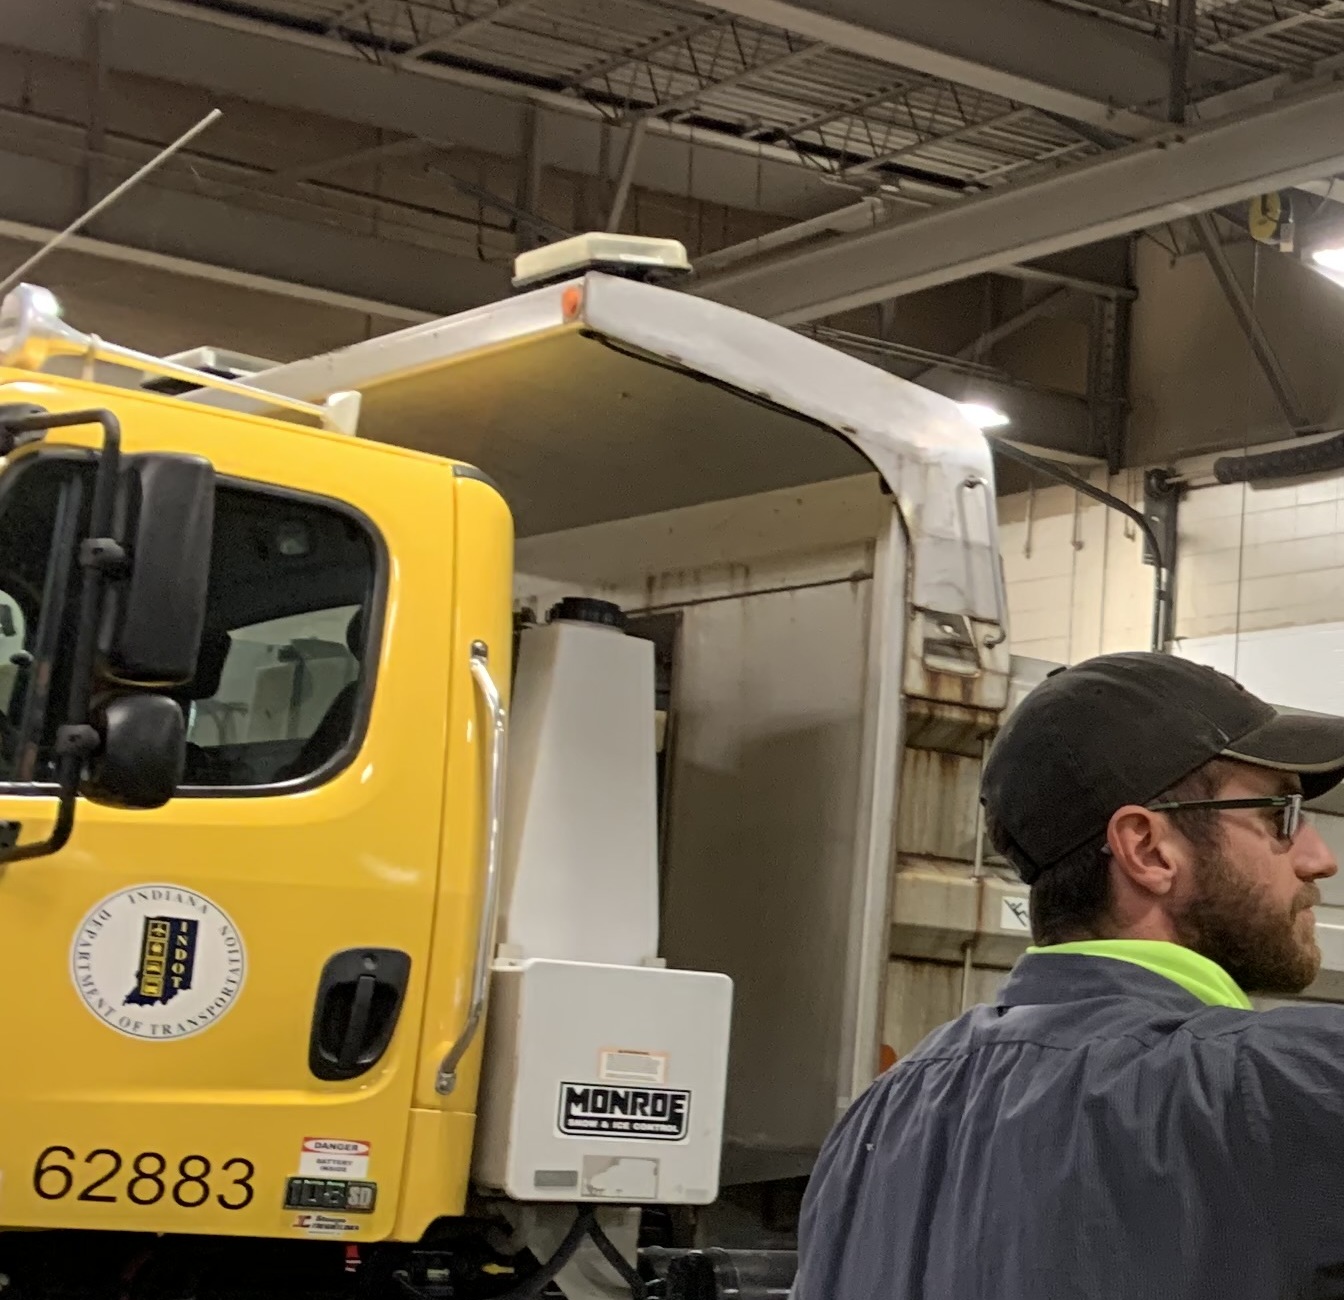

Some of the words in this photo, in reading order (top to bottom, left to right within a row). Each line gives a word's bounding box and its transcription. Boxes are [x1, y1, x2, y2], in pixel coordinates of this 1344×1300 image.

[127, 889, 208, 914] INDIANA
[170, 921, 189, 989] INDOT
[77, 908, 117, 1018] DEPARTMENT
[118, 1016, 143, 1033] OF
[150, 925, 241, 1036] TRANSPORTATION
[565, 1086, 686, 1118] MONROE
[567, 1118, 598, 1128] SNOW
[612, 1121, 631, 1131] ICE
[632, 1122, 680, 1133] CONTROL
[314, 1141, 359, 1151] DANGER
[33, 1145, 256, 1211] 62883
